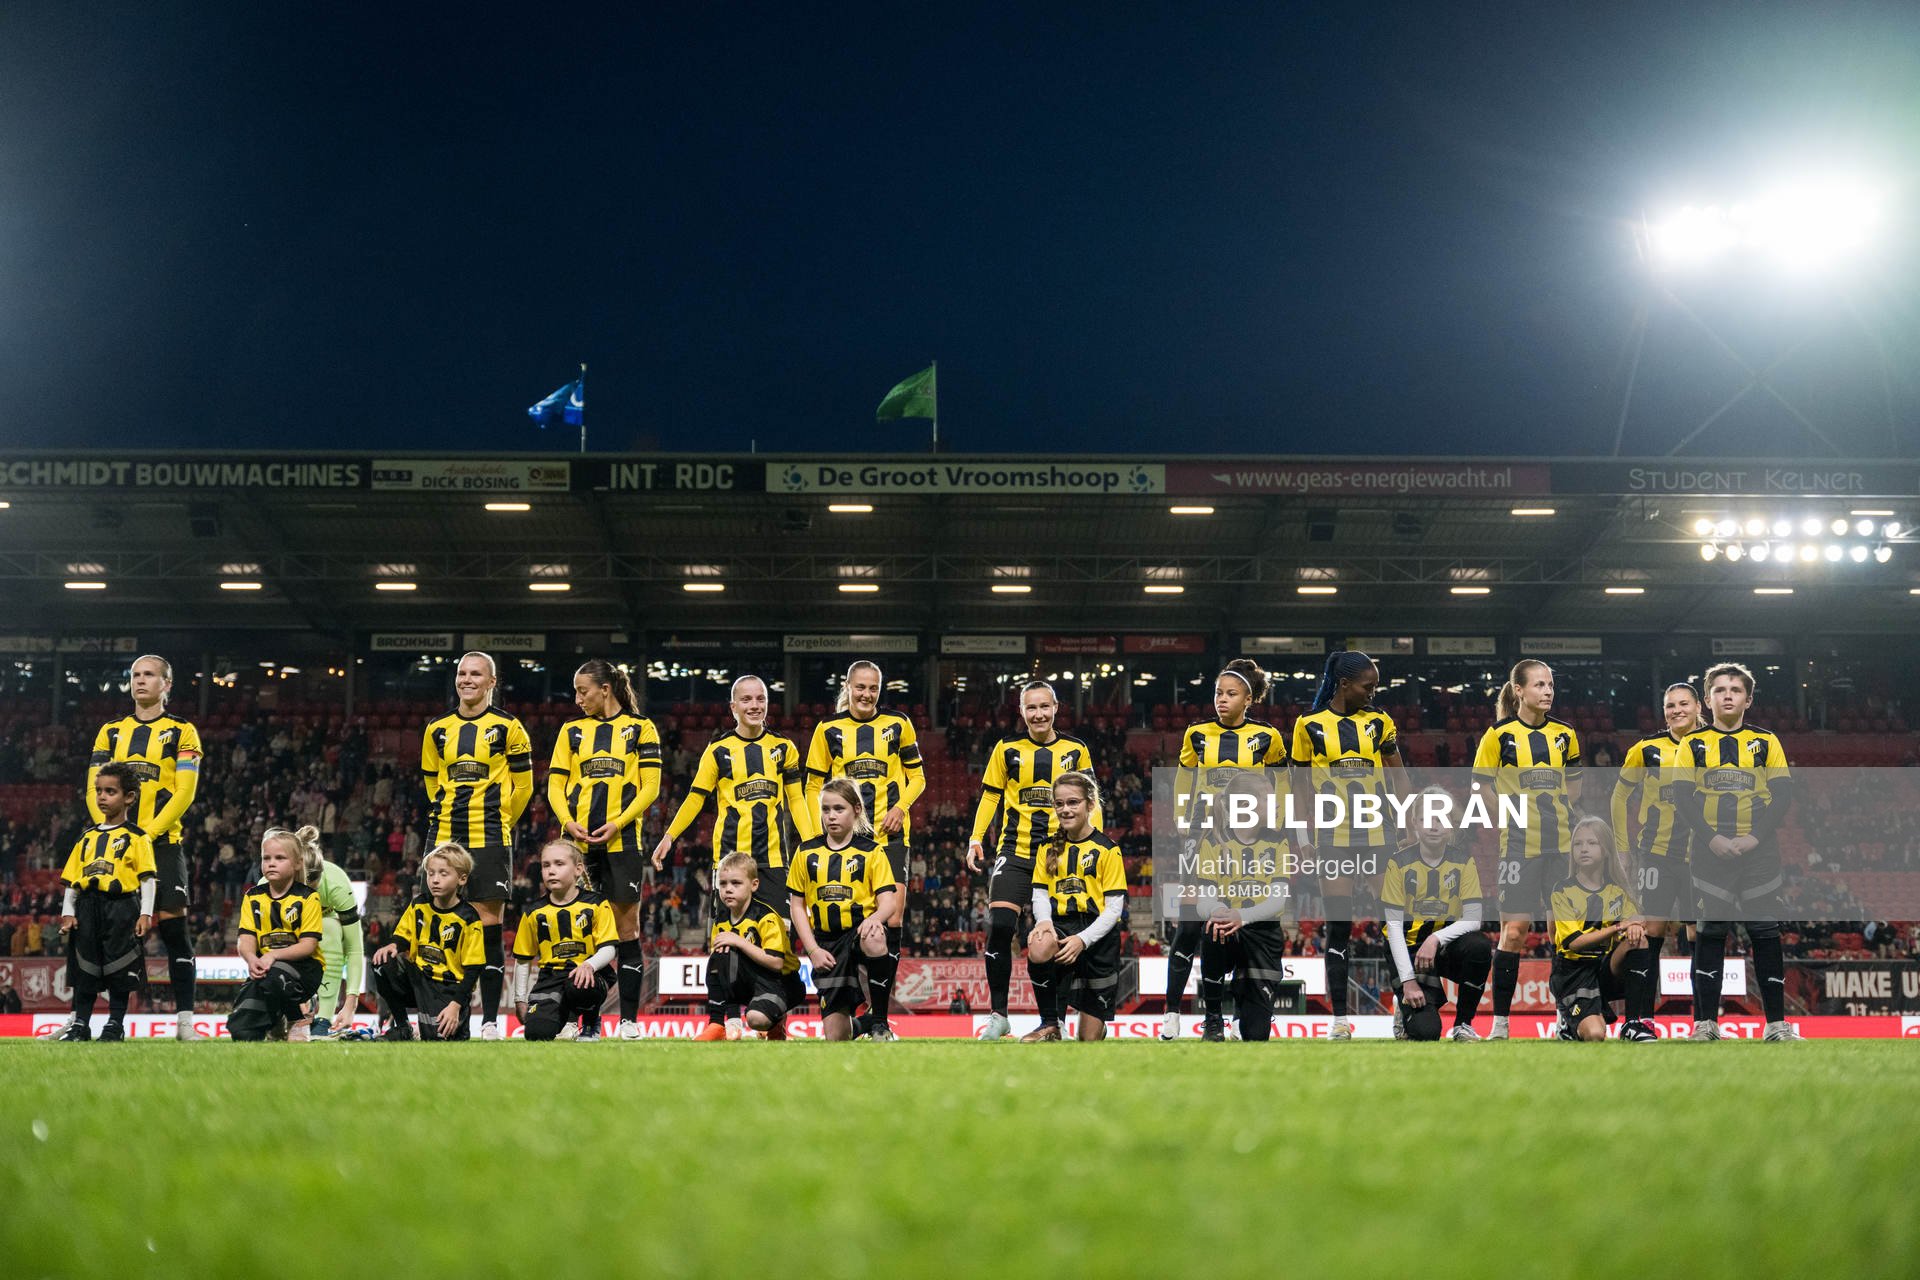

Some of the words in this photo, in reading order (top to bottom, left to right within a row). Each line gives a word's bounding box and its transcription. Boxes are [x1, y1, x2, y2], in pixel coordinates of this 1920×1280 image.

[136, 463, 359, 487] BOUWMACHINES
[422, 476, 457, 488] DICK
[463, 476, 519, 488] BOSING
[676, 464, 733, 489] RDC
[818, 467, 853, 486] De
[860, 466, 938, 486] Groot
[947, 466, 1119, 492] Vroomshoop
[1236, 468, 1511, 493] www.geas-energiewacht.nl
[1498, 861, 1520, 885] 28
[1637, 867, 1659, 890] 30
[1825, 971, 1892, 998] MAKE
[1901, 971, 1920, 998] U
